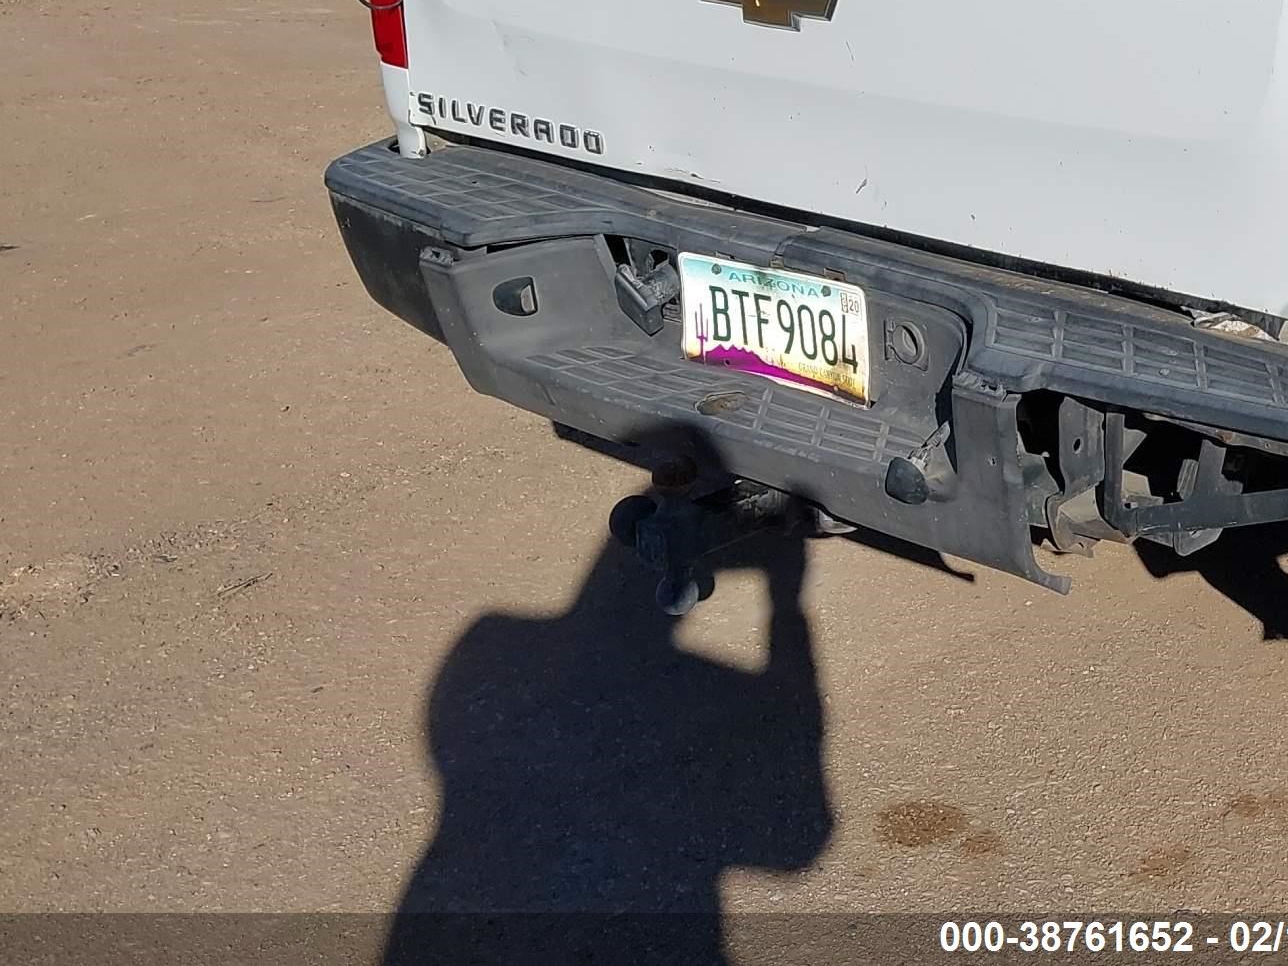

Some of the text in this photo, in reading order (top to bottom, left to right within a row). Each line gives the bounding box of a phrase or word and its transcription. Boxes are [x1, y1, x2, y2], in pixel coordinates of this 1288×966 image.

[416, 91, 606, 155] SILVERADO
[728, 271, 820, 299] ARIZONA
[848, 298, 860, 314] 20
[709, 284, 859, 374] BTF9084
